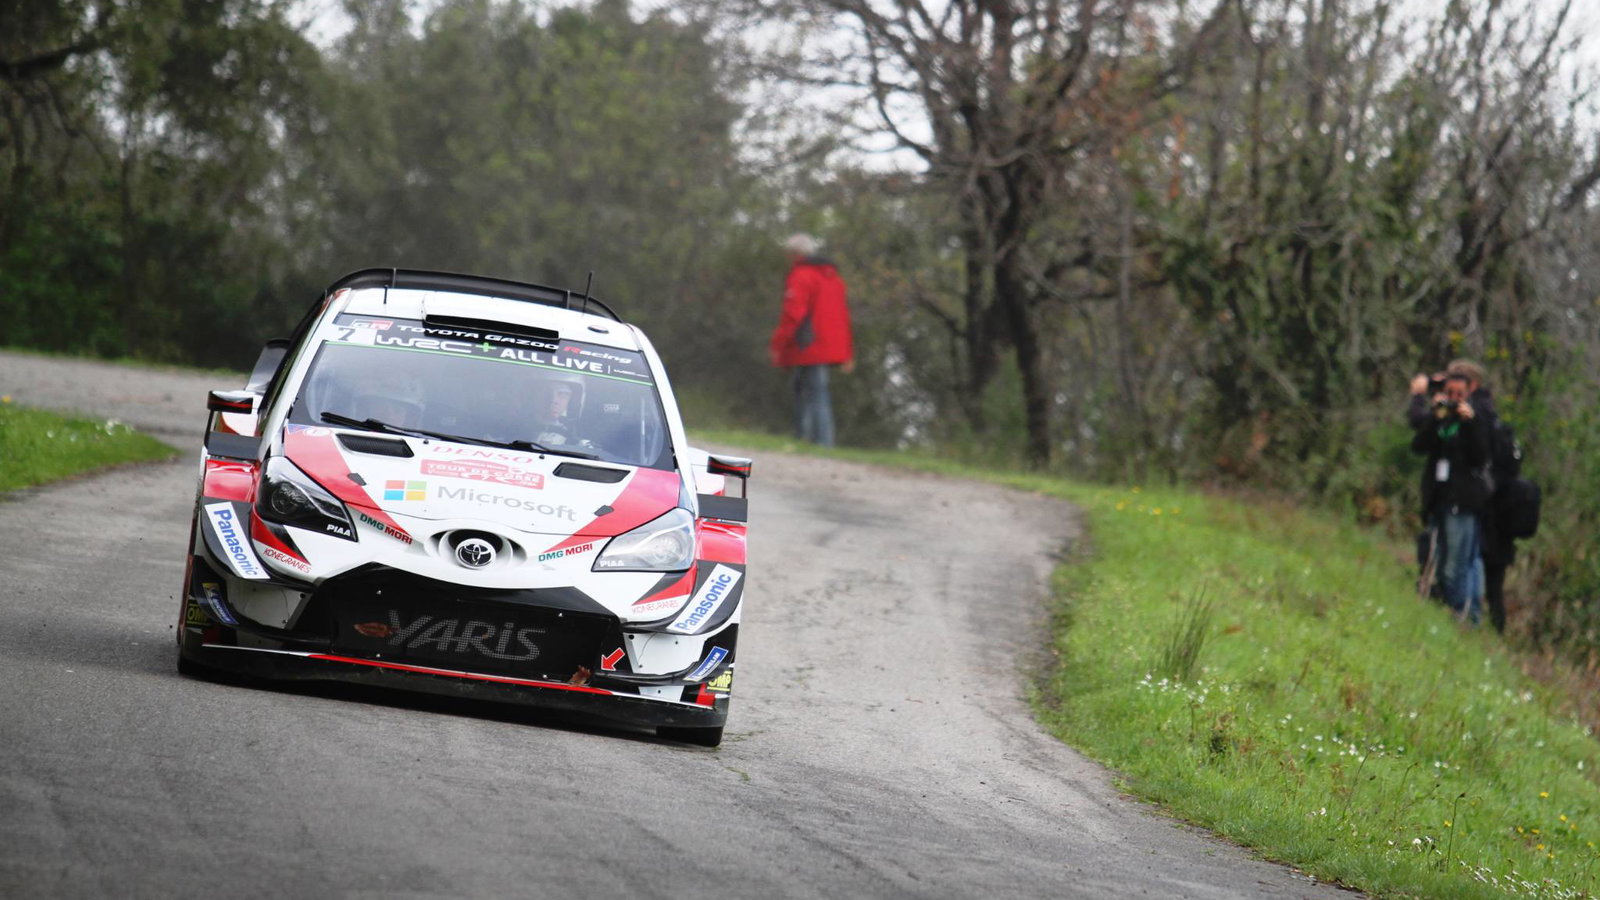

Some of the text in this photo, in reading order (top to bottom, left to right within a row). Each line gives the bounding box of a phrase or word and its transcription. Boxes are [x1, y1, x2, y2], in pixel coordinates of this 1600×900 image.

[396, 325, 632, 364] TOYOTA GAZOO Racing
[500, 348, 545, 363] ALL
[552, 356, 603, 373] LIVE
[433, 446, 533, 464] DENSO
[426, 463, 467, 473] TOUR
[471, 468, 489, 476] DE
[494, 471, 540, 483] CORSE
[437, 486, 577, 521] Microsoft
[326, 524, 351, 537] PIAA
[360, 513, 413, 545] DMG MORI
[214, 509, 258, 576] Panasonic
[538, 543, 593, 562] DMG MORI
[600, 559, 625, 568] PIAA
[674, 573, 732, 631] Panasonic
